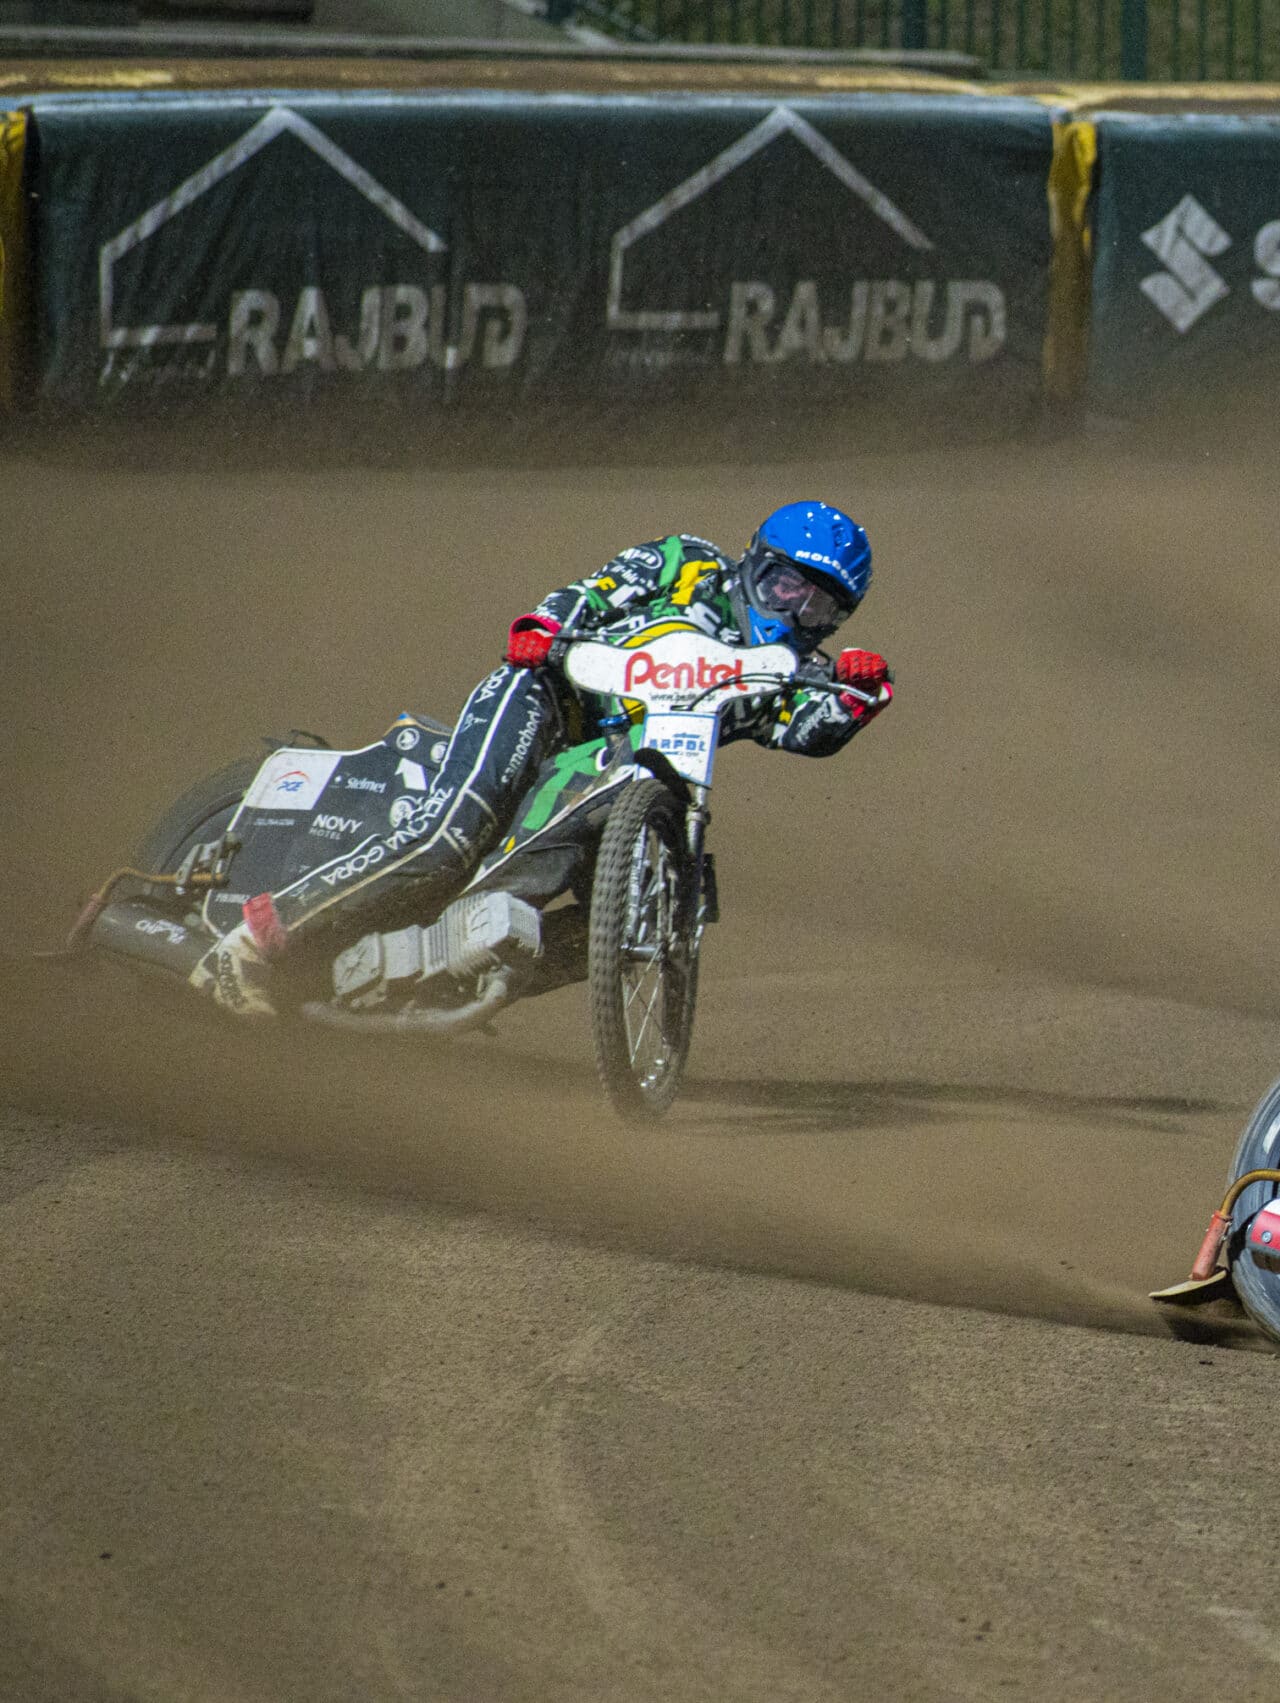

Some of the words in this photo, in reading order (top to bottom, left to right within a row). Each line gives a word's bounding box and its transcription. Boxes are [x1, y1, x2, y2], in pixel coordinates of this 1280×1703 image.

[723, 279, 1007, 364] RAJBUD
[624, 651, 749, 693] Pentel
[308, 827, 341, 841] HOTEL
[313, 813, 364, 835] NOVY
